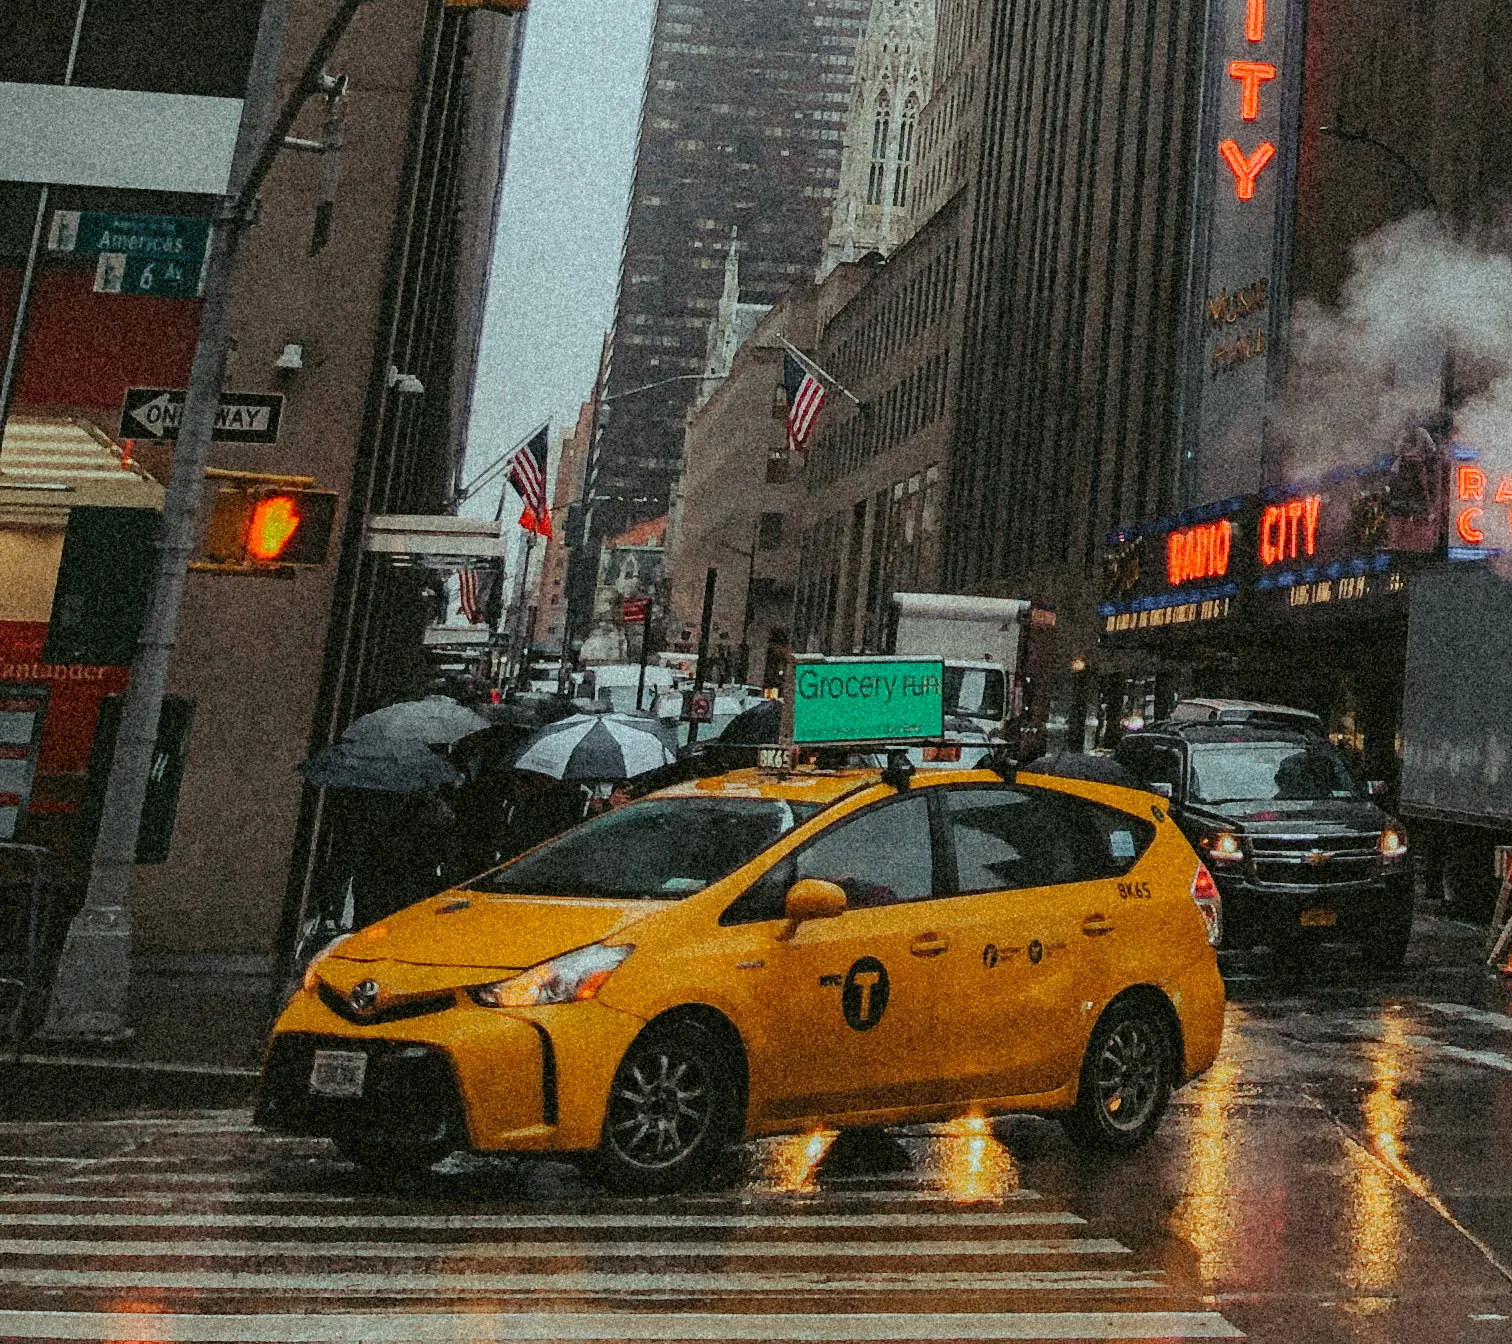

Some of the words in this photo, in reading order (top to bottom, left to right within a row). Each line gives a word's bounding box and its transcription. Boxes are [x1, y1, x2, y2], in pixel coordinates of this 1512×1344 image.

[97, 230, 184, 253] Americas
[139, 262, 155, 289] 6
[147, 404, 182, 424] ON
[1167, 517, 1232, 587] RADIO
[1260, 494, 1321, 566] CITY
[0, 662, 108, 680] antander
[798, 669, 897, 706] Grocery
[903, 674, 940, 697] run
[854, 972, 880, 1021] T
